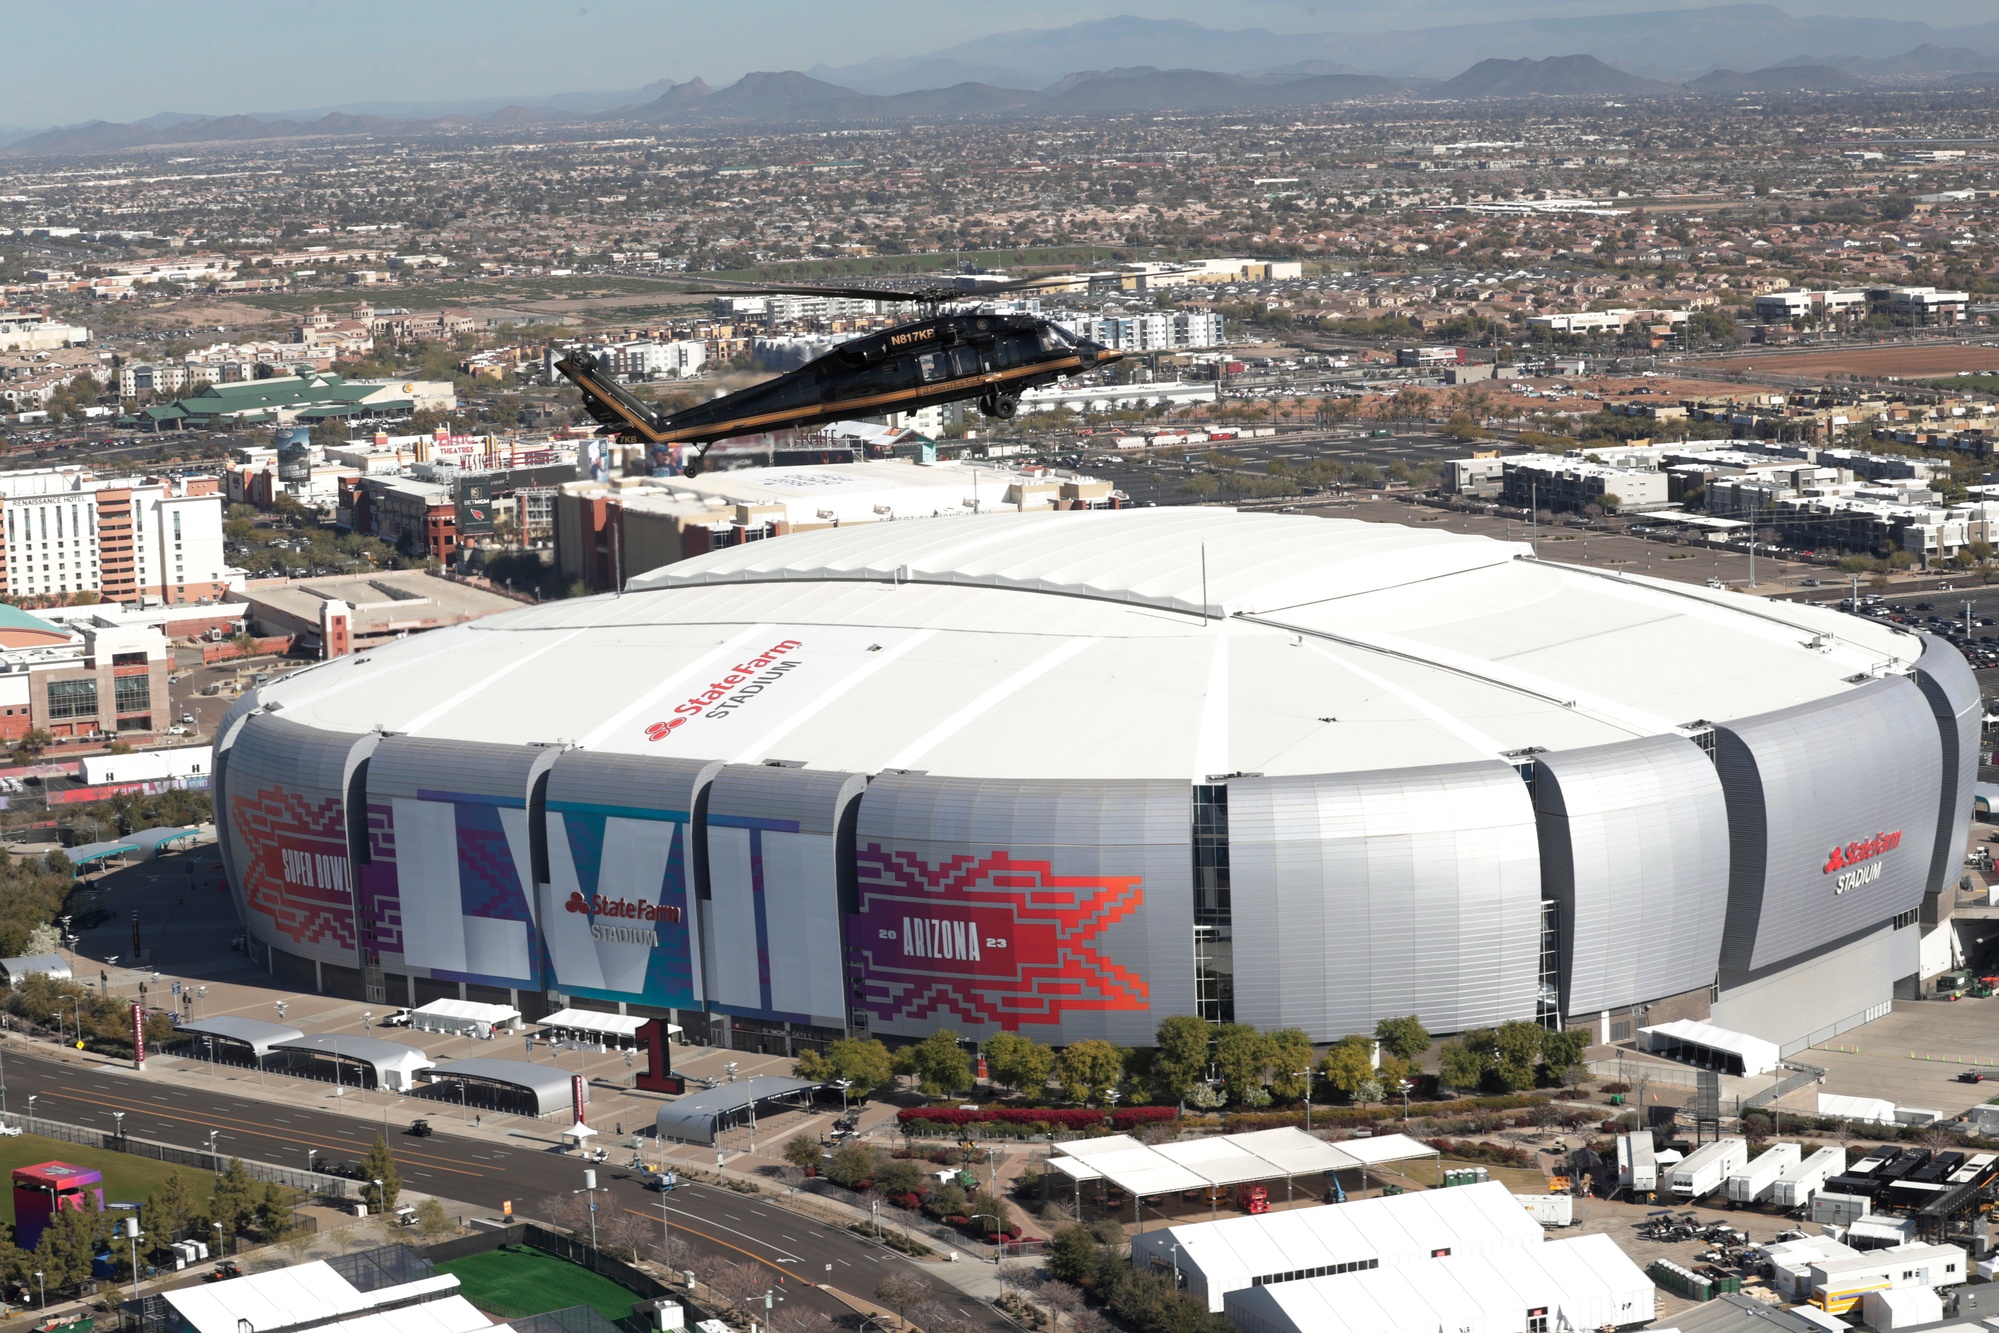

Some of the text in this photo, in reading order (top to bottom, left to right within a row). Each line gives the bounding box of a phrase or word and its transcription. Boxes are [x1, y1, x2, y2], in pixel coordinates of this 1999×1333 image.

[440, 447, 474, 455] THEATRES
[13, 498, 61, 507] RENAISSANCE
[705, 661, 802, 719] STADIUM
[282, 848, 352, 892] SUPER BOWL
[1834, 861, 1883, 895] STADIUM
[591, 924, 659, 948] STADIUM
[878, 916, 1007, 962] 20 ARIZONA 23
